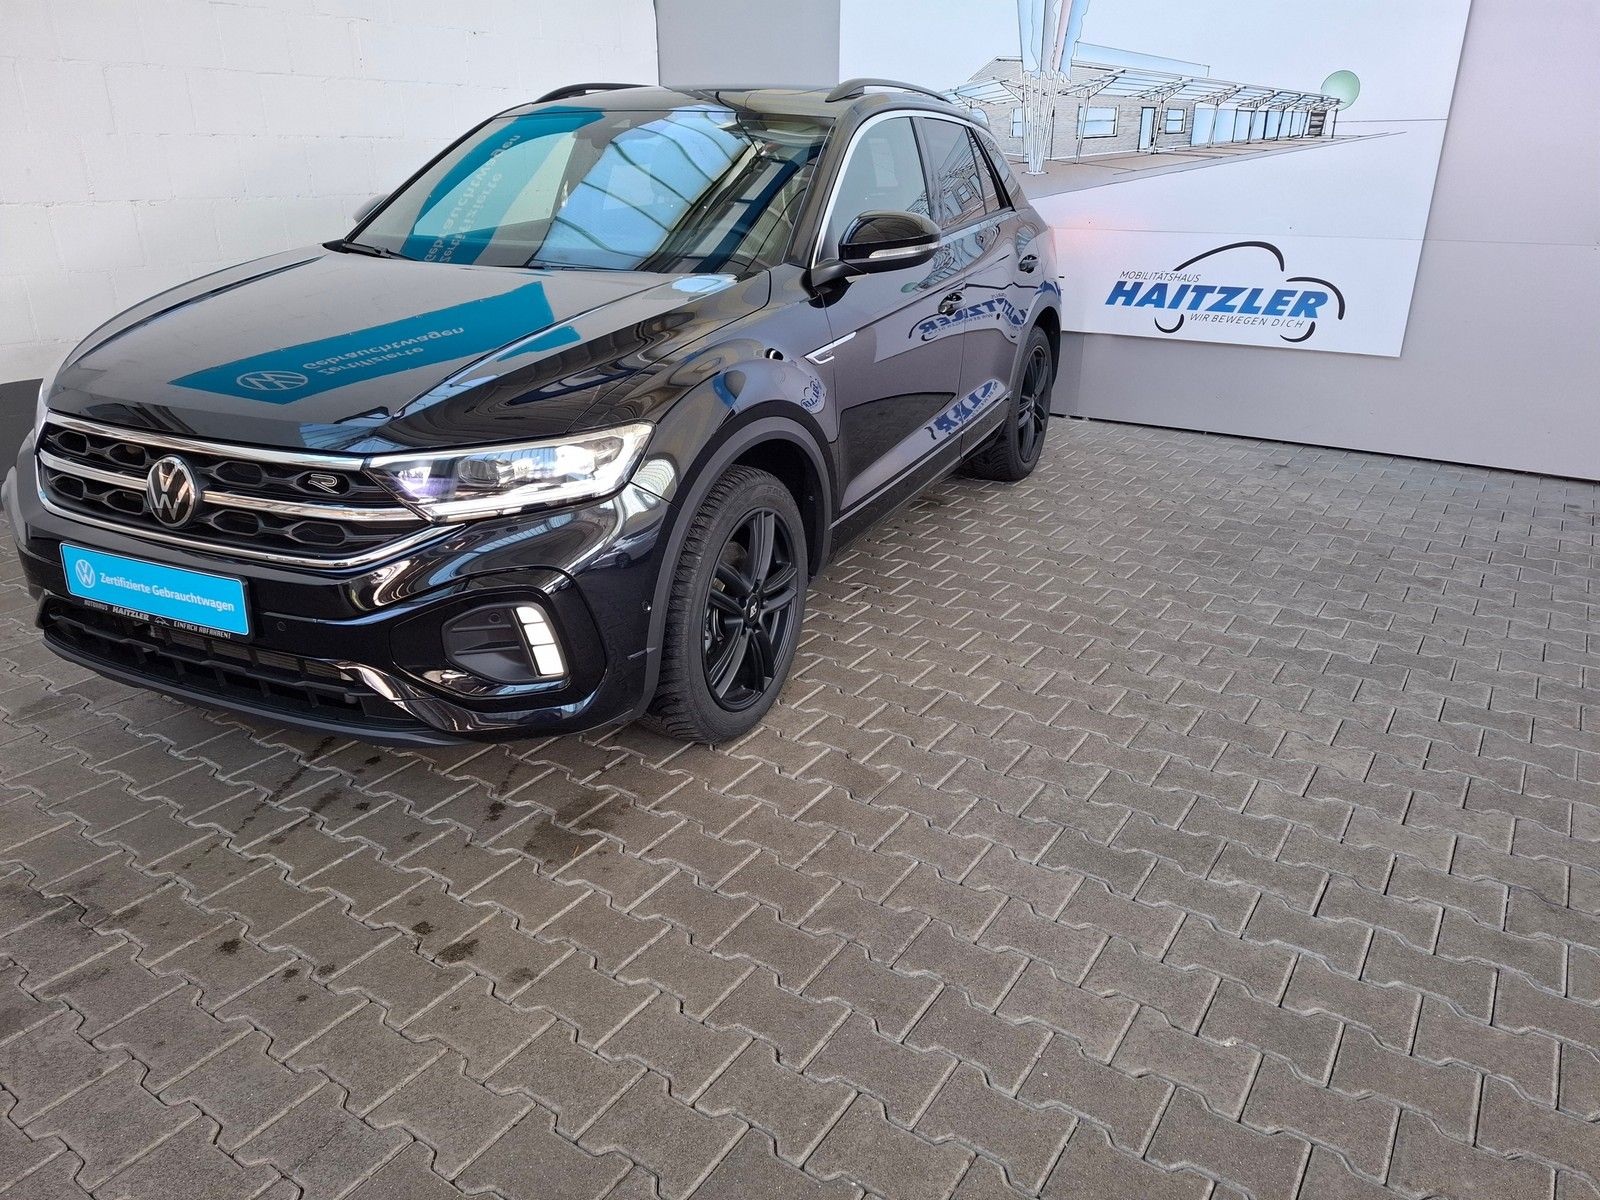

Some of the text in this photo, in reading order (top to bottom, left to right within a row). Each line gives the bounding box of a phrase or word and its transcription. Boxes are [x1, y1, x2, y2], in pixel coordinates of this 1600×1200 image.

[1119, 270, 1201, 283] MOBILITÄTSHAUS
[1105, 281, 1328, 318] HAITZLER
[1190, 313, 1305, 328] WIR BEWEGEN DICH
[99, 572, 235, 612] Zertifizierte Gebrauchtwagen
[112, 606, 150, 621] HAITZLER
[173, 621, 198, 632] EINFACH
